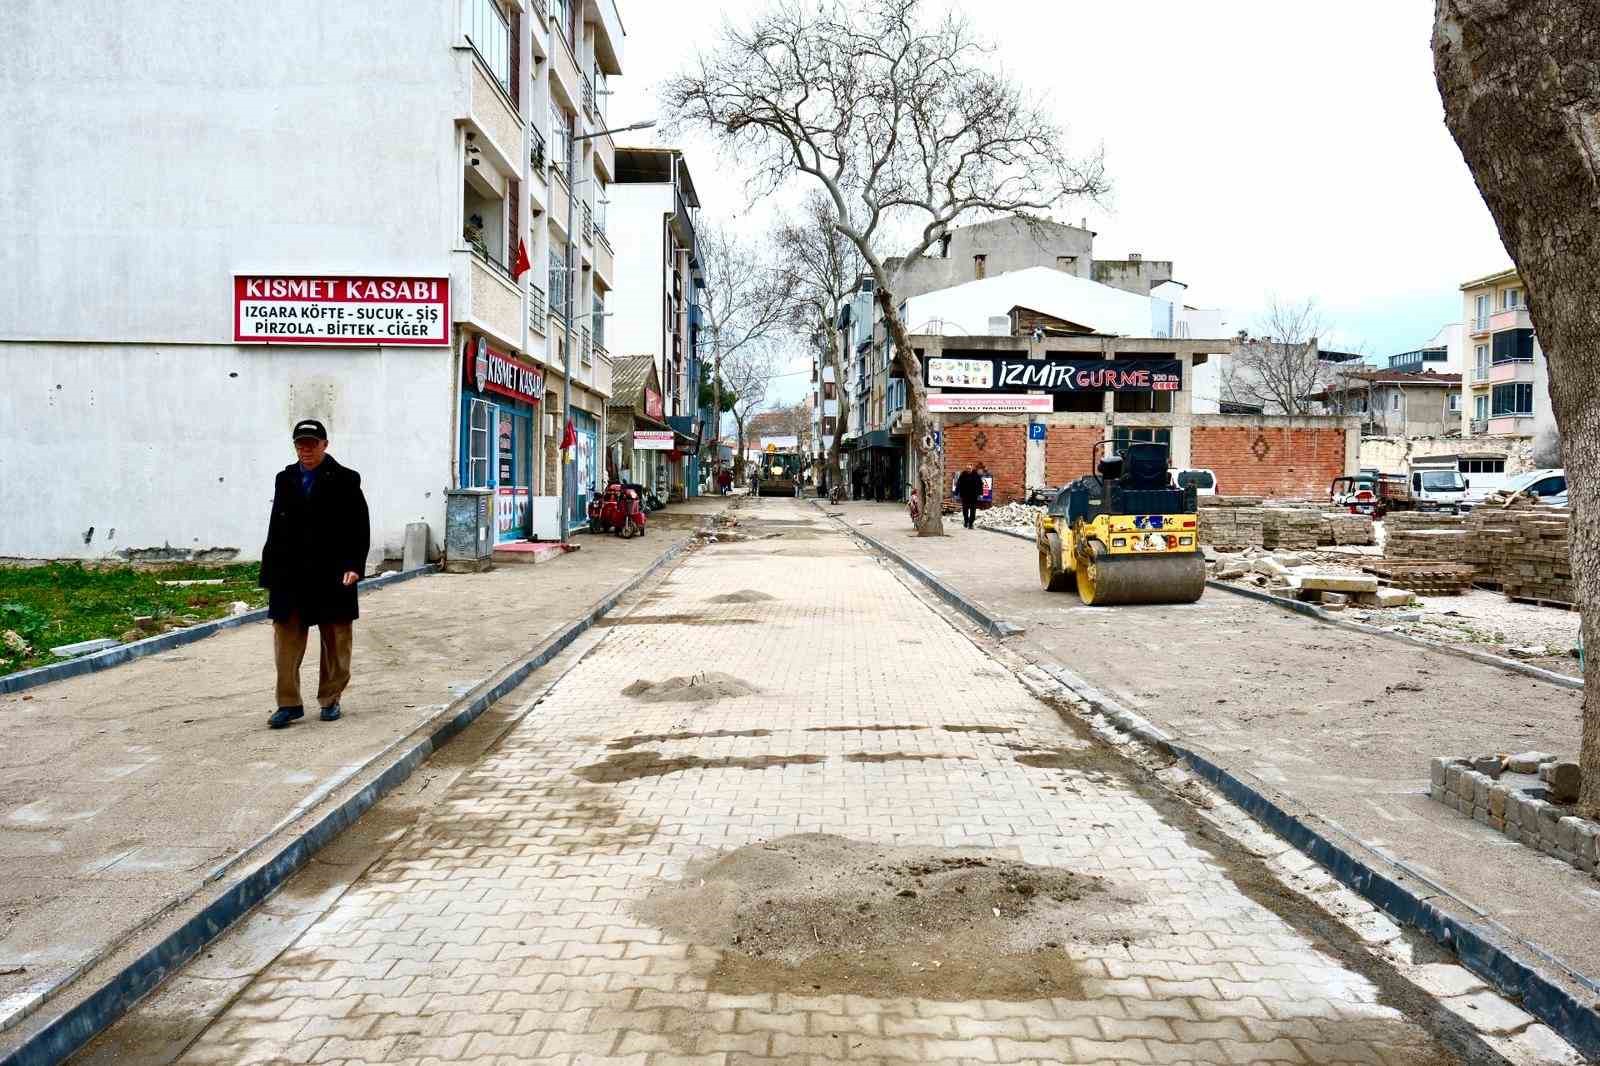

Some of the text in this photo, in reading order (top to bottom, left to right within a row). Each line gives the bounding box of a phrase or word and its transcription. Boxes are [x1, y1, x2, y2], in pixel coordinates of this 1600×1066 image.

[246, 279, 438, 300] KISMET KASABI
[245, 306, 298, 318] IZGARA
[301, 304, 344, 319] KÖFTE
[356, 307, 404, 320] SUCUK
[416, 305, 438, 323] ŞİŞ
[255, 319, 315, 335] PİRZOLA
[327, 320, 375, 336] BİFTEK
[387, 321, 428, 336] CİĞER
[488, 354, 519, 390] KISMET
[519, 368, 544, 400] KASABI
[998, 361, 1075, 390] İZMİR
[1077, 369, 1151, 388] GURME
